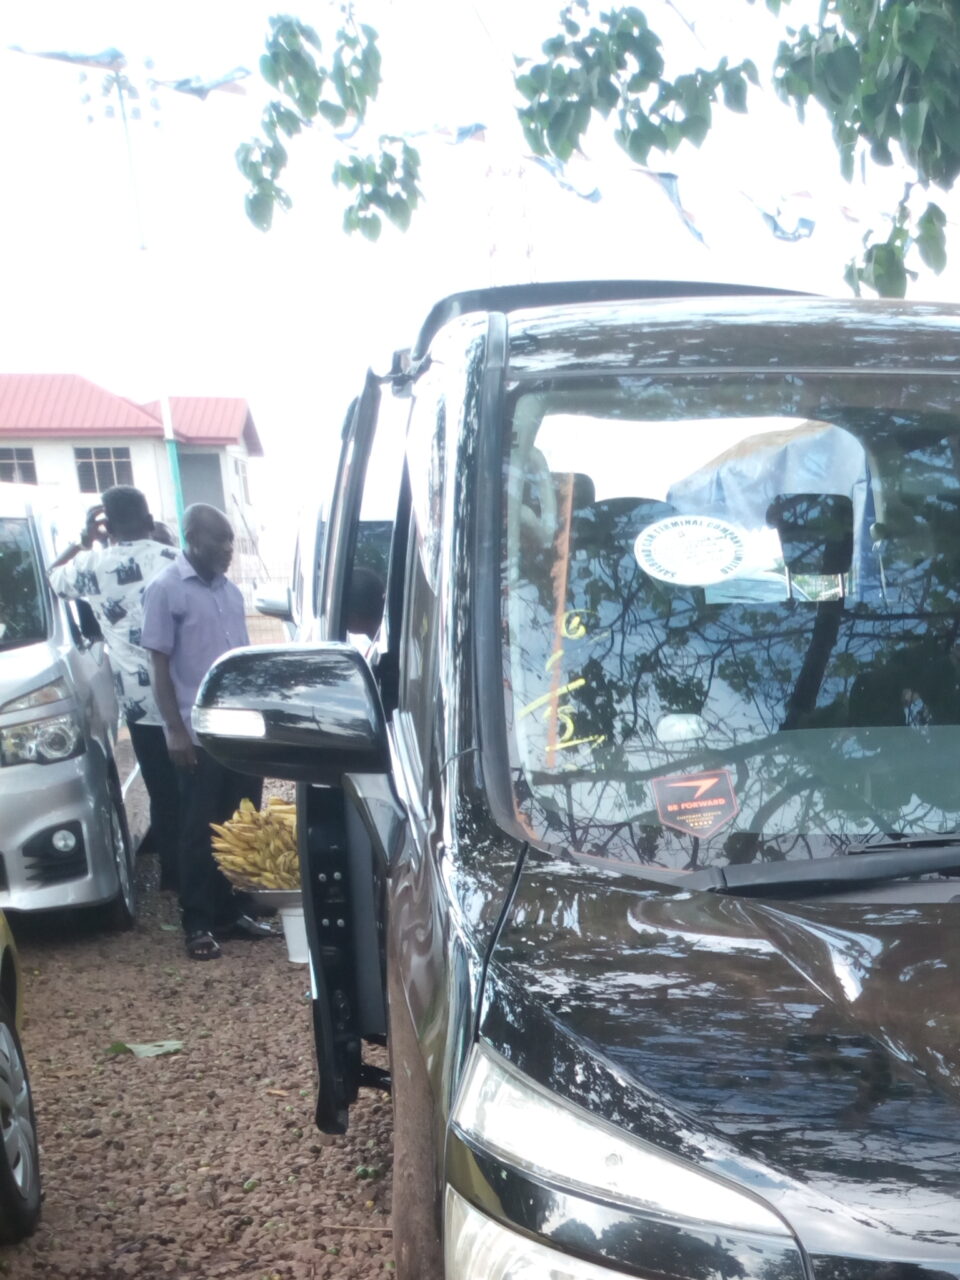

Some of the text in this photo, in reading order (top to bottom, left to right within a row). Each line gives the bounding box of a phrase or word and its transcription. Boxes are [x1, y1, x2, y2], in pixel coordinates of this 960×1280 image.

[653, 519, 703, 534] TERMINAL
[706, 522, 743, 547] COMPANY
[720, 550, 745, 574] LIMITED
[667, 798, 726, 812] BE FORWARD
